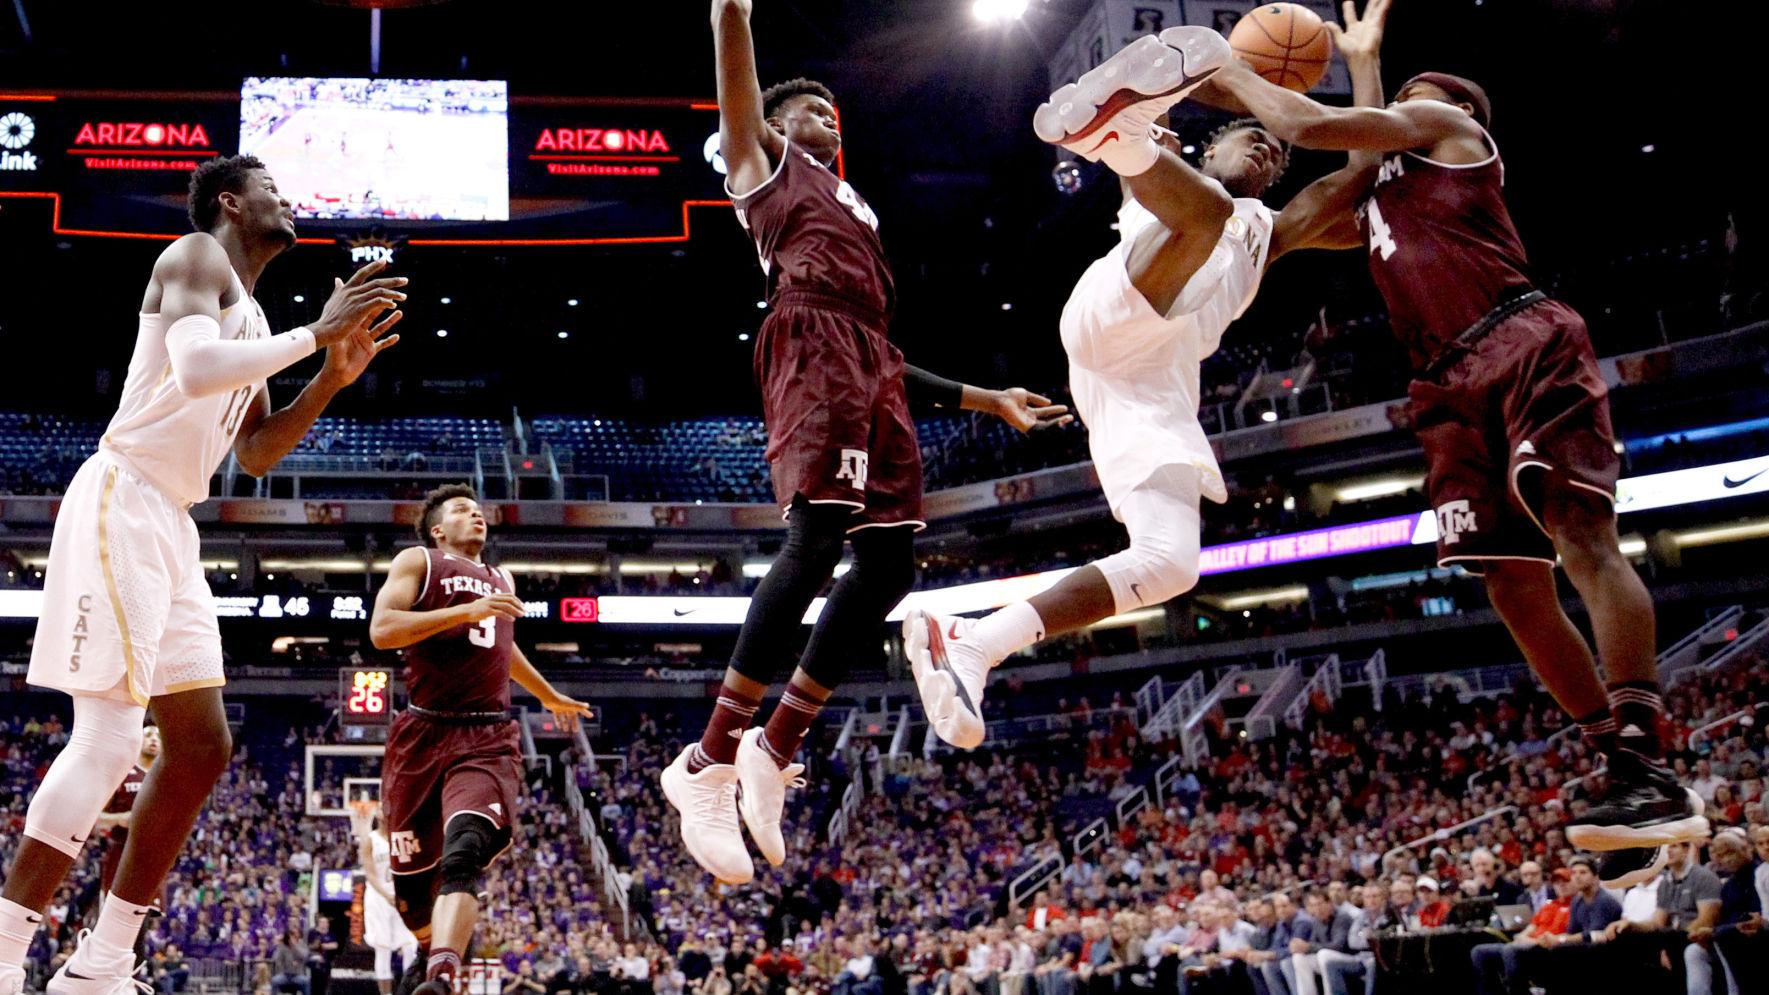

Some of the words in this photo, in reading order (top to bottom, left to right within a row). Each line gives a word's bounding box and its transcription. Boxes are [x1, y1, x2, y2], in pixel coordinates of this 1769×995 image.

[74, 122, 210, 146] ARIZONA
[535, 128, 670, 152] ARIZONA
[0, 150, 37, 170] ink
[84, 157, 197, 172] VisitArizona.com
[547, 162, 660, 176] VisitArizona.com
[351, 246, 394, 263] PHX
[1329, 519, 1411, 551] SHOOTOUT
[440, 576, 492, 597] TEXAS
[69, 594, 91, 673] CATS
[469, 615, 496, 649] 3
[349, 686, 384, 713] 26
